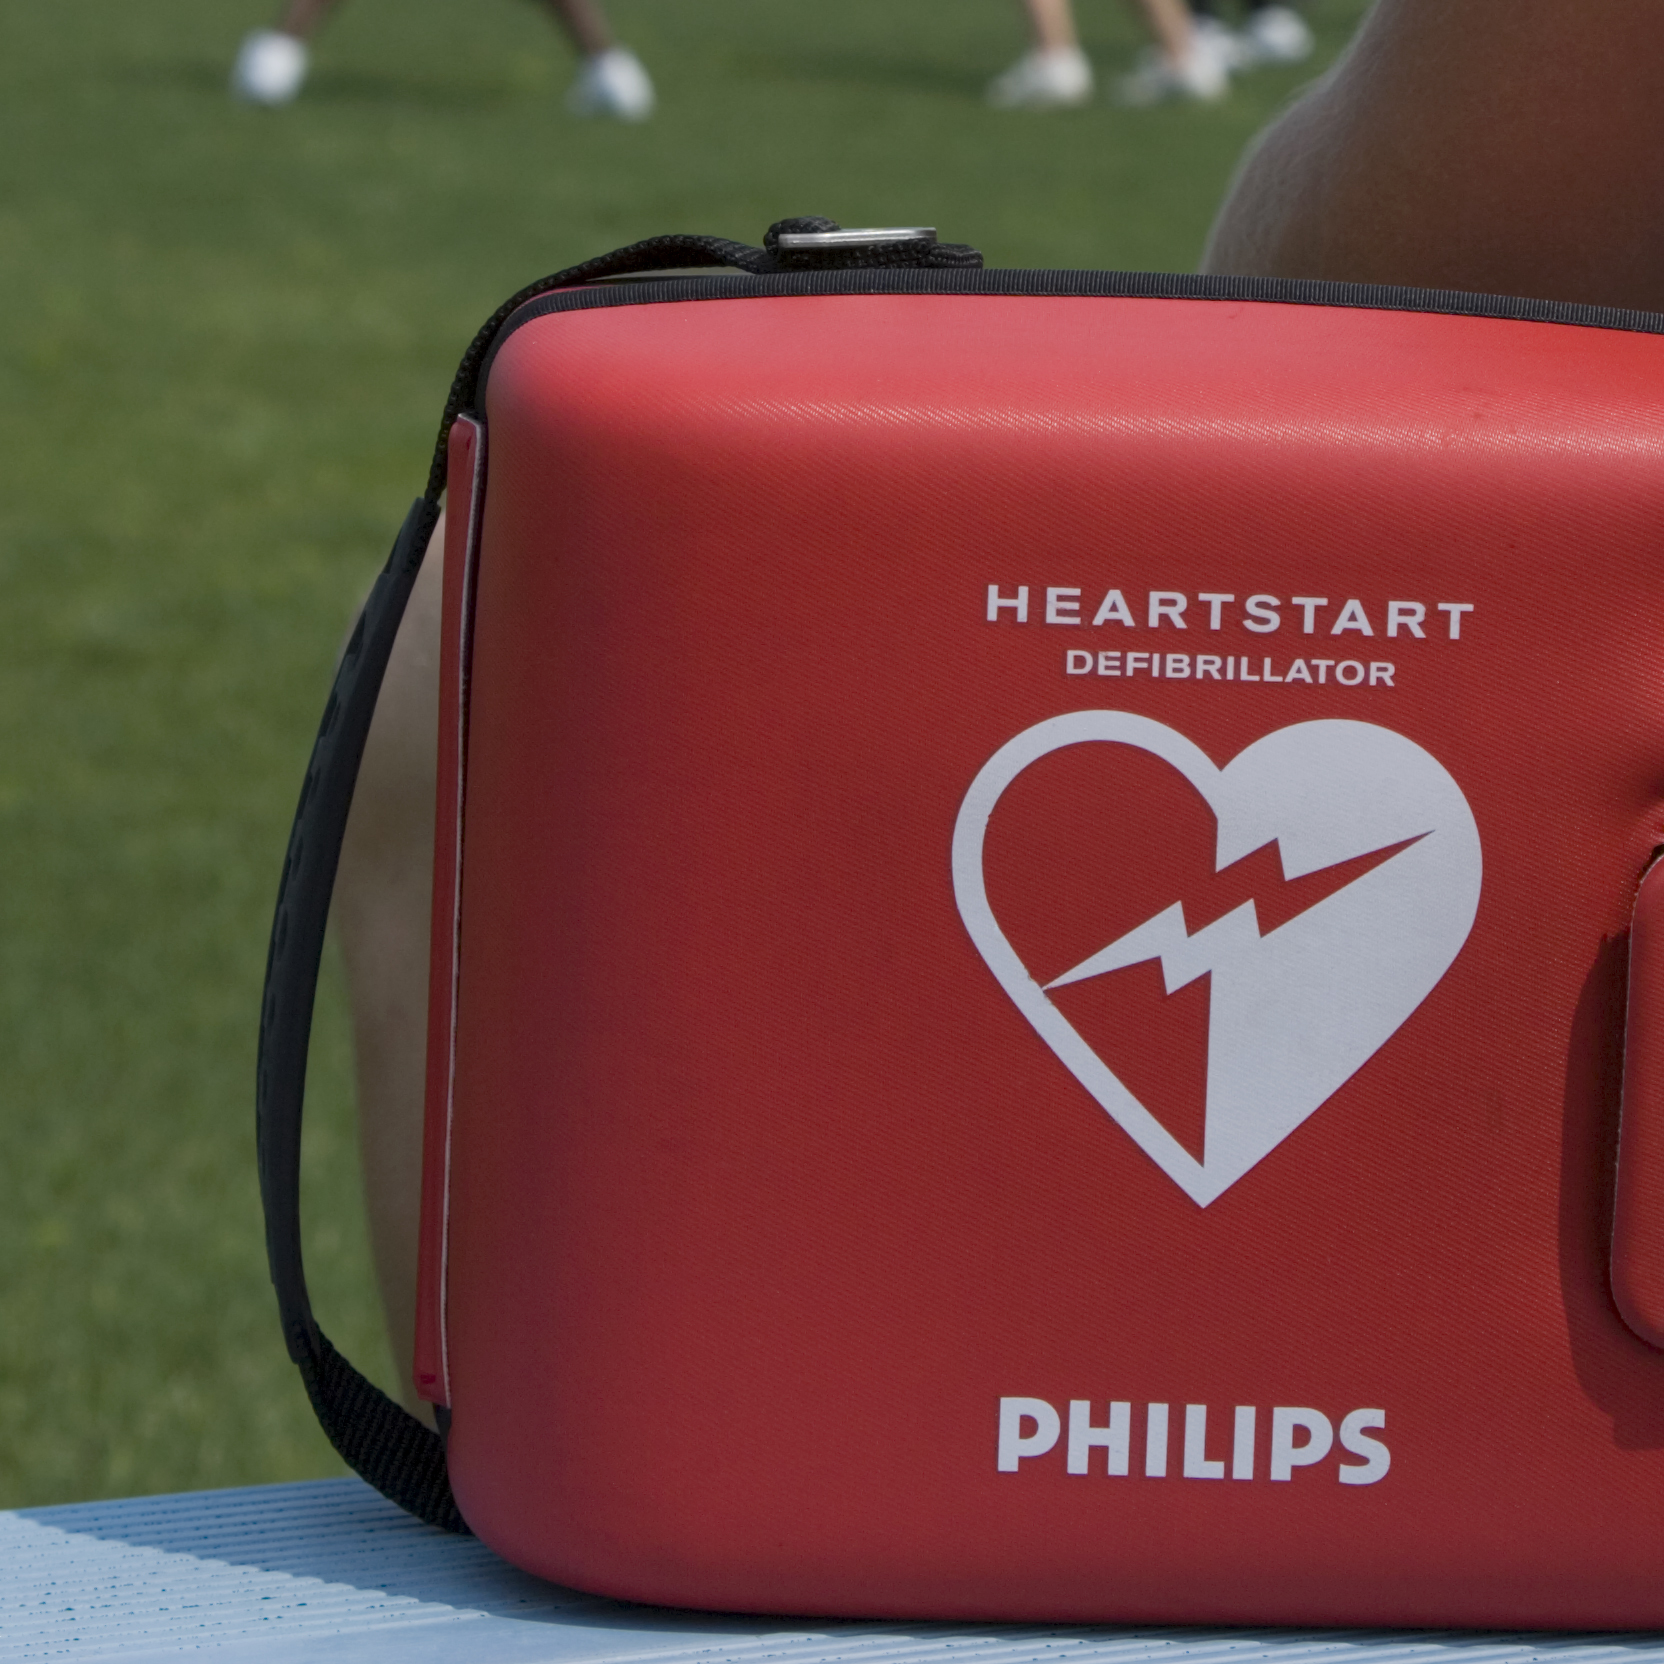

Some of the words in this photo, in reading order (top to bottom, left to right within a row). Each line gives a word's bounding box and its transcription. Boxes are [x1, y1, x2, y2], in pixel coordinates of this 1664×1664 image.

[985, 584, 1474, 640] HEARTSTART
[1065, 649, 1396, 687] DEFIBRILLATOR
[997, 1396, 1391, 1485] PHILIPS
